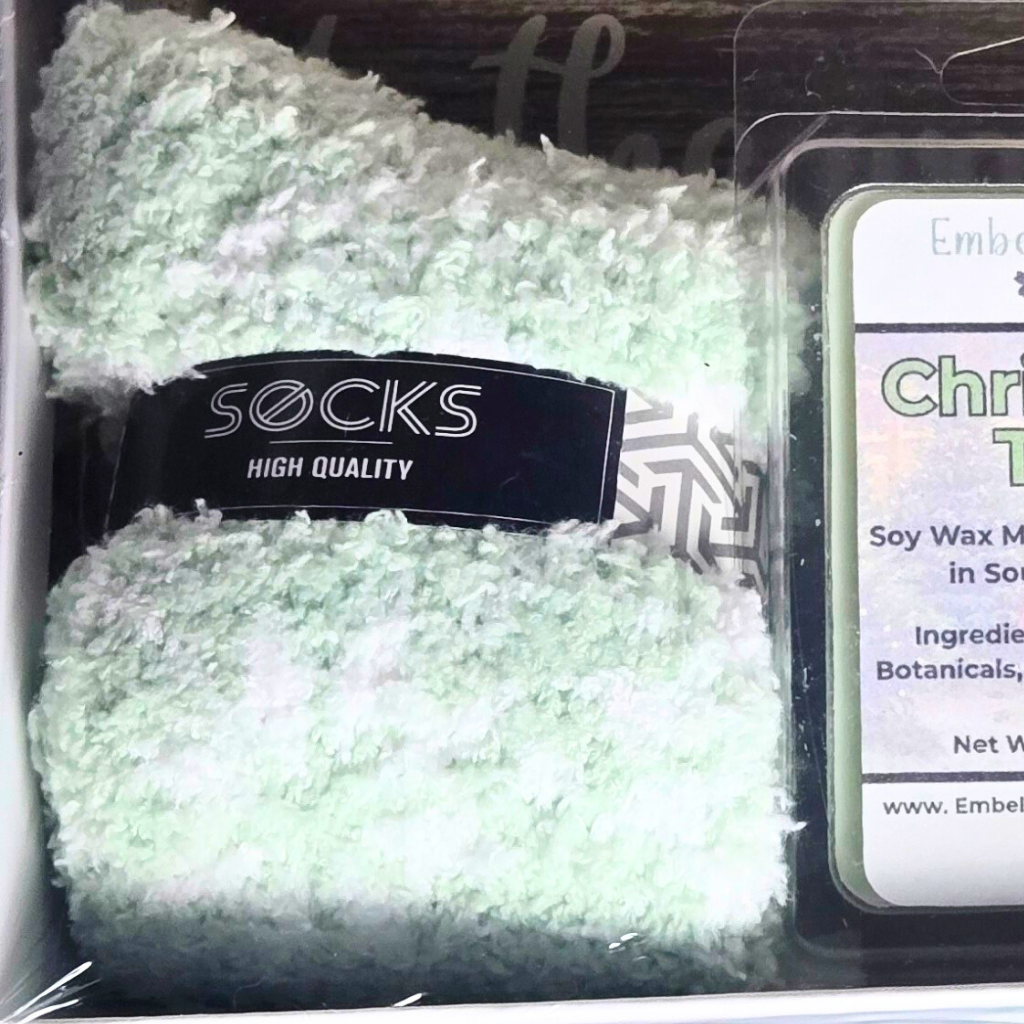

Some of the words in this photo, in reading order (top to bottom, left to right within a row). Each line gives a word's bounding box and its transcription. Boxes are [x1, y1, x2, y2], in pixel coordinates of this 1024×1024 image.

[247, 456, 303, 479] HIGH
[311, 456, 414, 481] QUALITY
[870, 525, 921, 551] Soy
[931, 526, 993, 546] Wax
[949, 561, 975, 584] in
[876, 659, 1023, 683] Botanicals,
[954, 735, 999, 754] Net
[883, 800, 948, 815] www.
